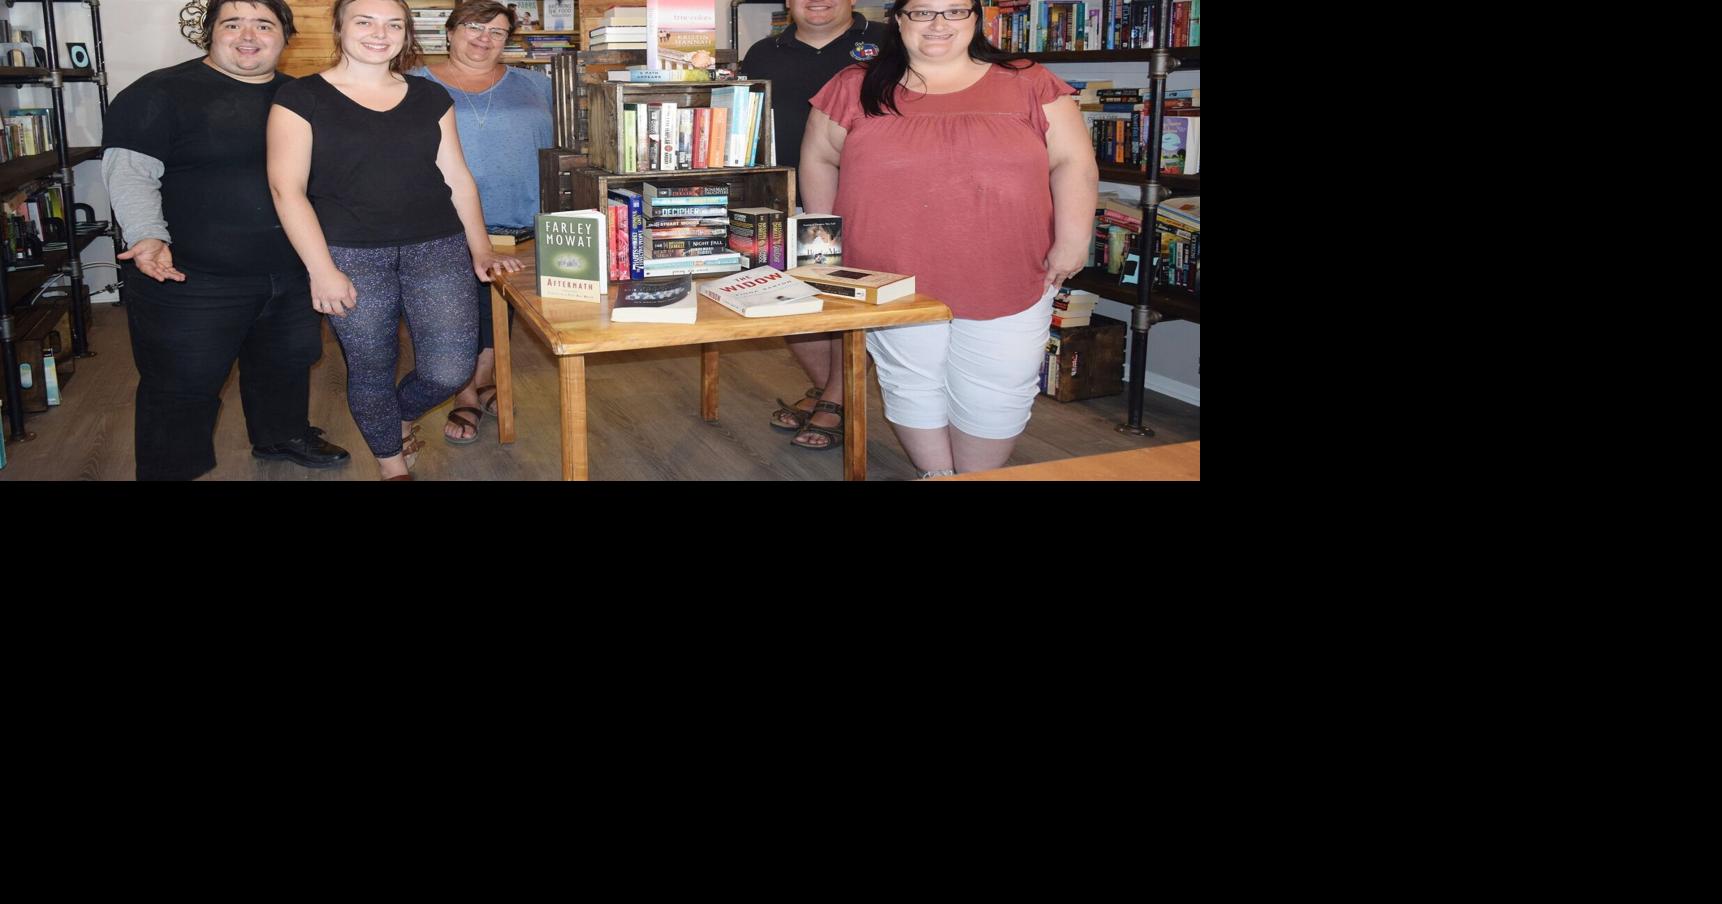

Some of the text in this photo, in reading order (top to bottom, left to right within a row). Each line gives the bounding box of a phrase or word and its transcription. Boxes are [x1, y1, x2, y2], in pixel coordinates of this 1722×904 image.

[662, 207, 700, 216] DECIPHER
[545, 221, 592, 235] FARLEY
[546, 233, 592, 248] MOWAT
[547, 278, 593, 291] AFTERMATH
[720, 272, 784, 293] WIDOW
[735, 274, 753, 282] THE
